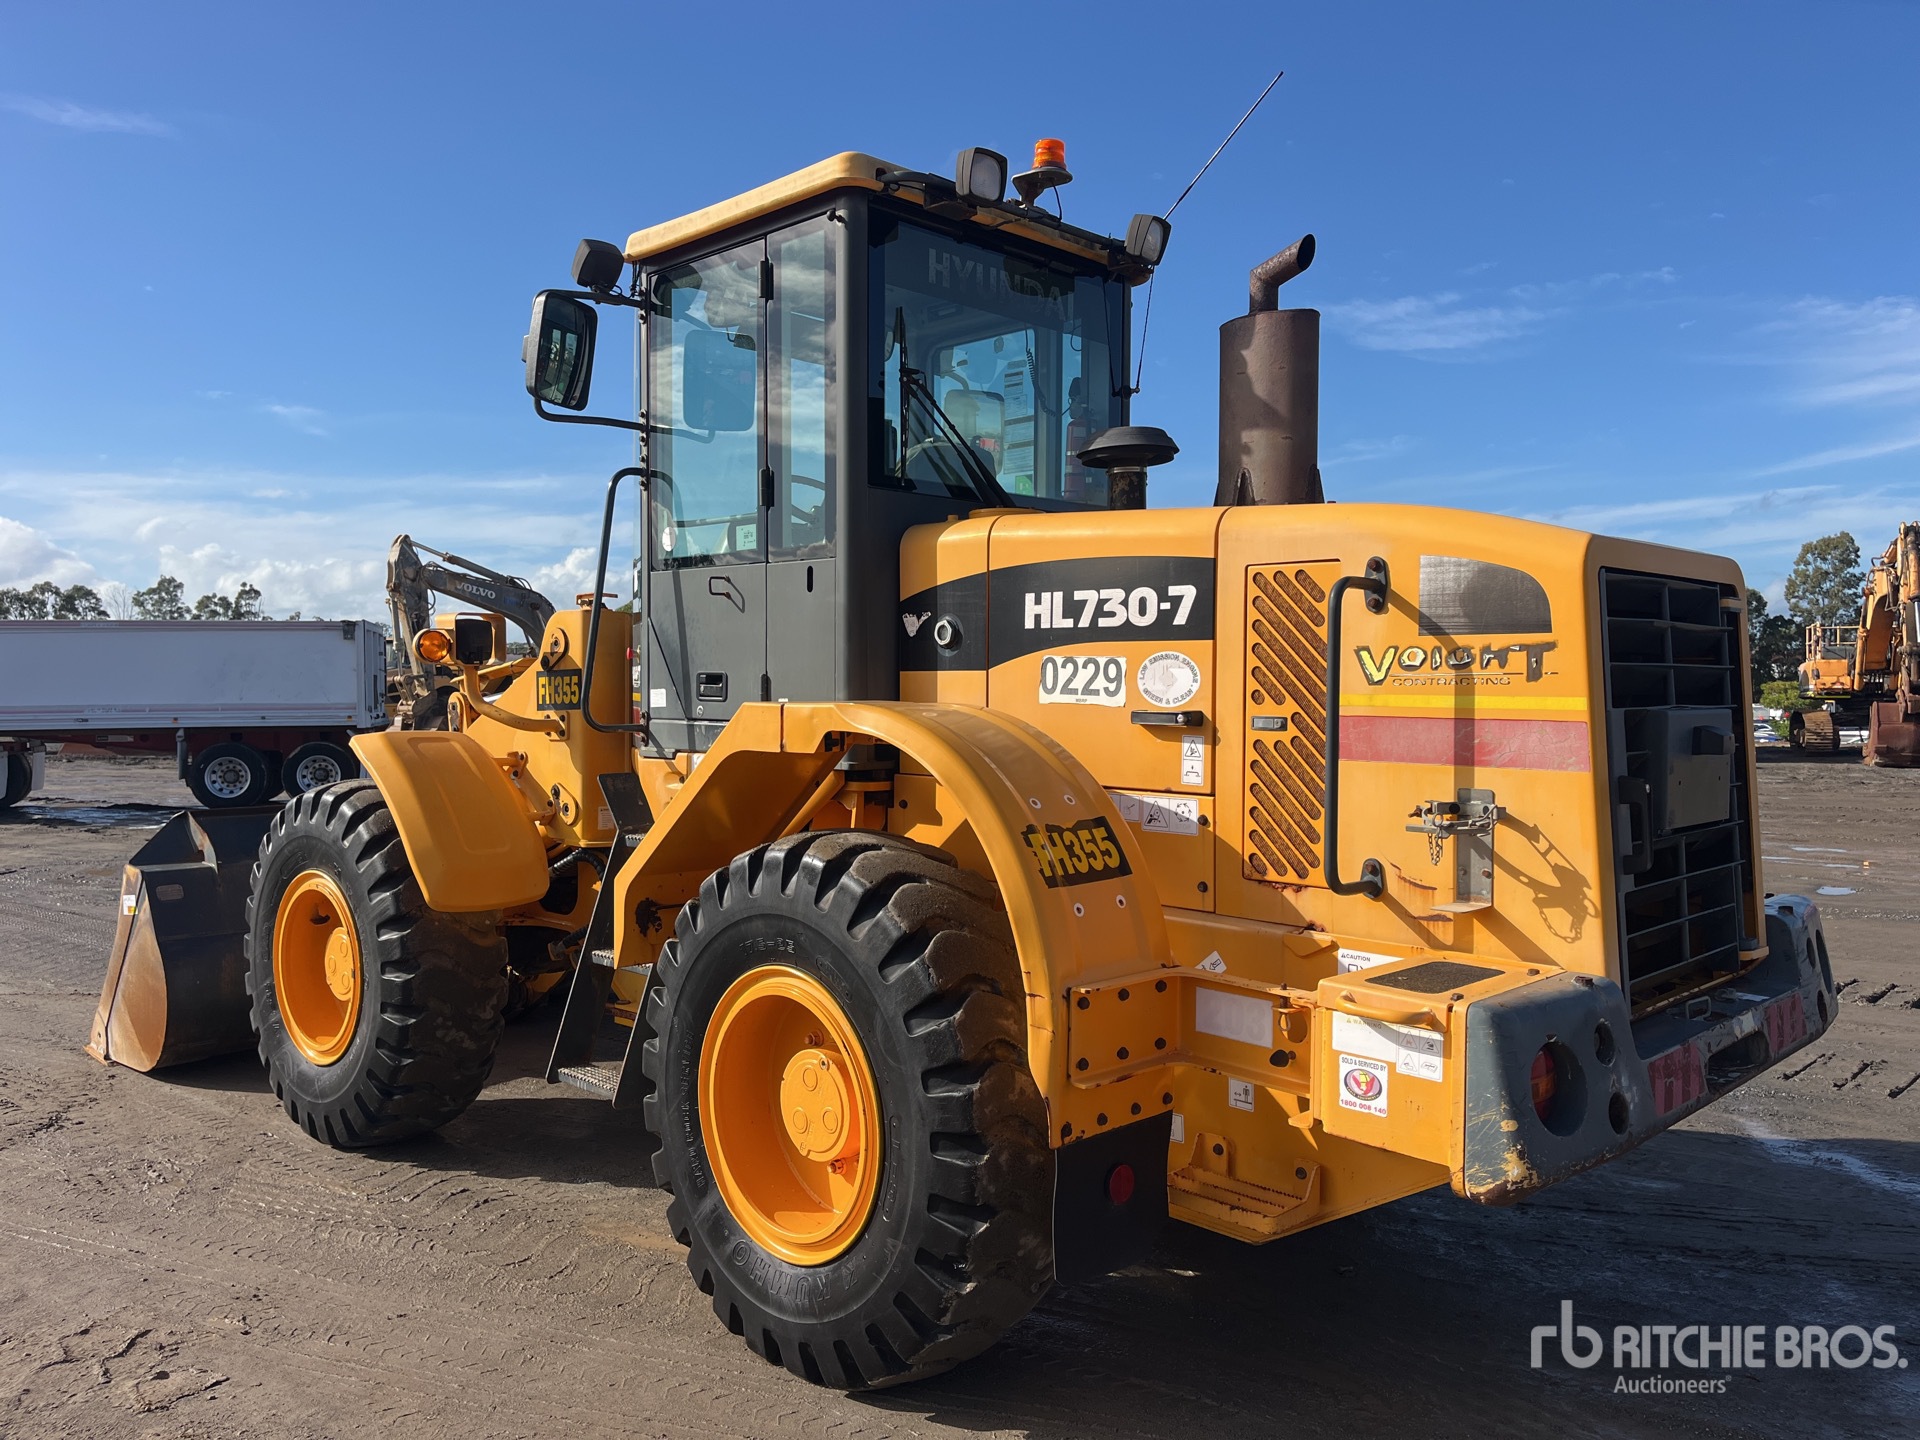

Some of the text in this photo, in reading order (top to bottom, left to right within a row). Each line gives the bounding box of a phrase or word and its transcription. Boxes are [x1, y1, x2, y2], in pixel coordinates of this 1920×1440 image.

[456, 581, 496, 600] VOLVO
[1024, 584, 1197, 630] HL730-7
[1041, 656, 1123, 698] 0229
[1139, 663, 1148, 680] LOW
[538, 675, 579, 705] FH355
[1392, 677, 1511, 686] CONTRACTING
[1172, 688, 1194, 704] CLEAN
[1027, 826, 1121, 877] FH355
[1345, 953, 1371, 962] CAUTION
[1353, 1018, 1382, 1030] WARNING
[1341, 1056, 1353, 1065] SOLD
[1358, 1059, 1379, 1070] SERVICED
[1341, 1099, 1356, 1108] 1800
[1374, 1107, 1387, 1115] 140
[730, 1240, 832, 1303] KUMHO
